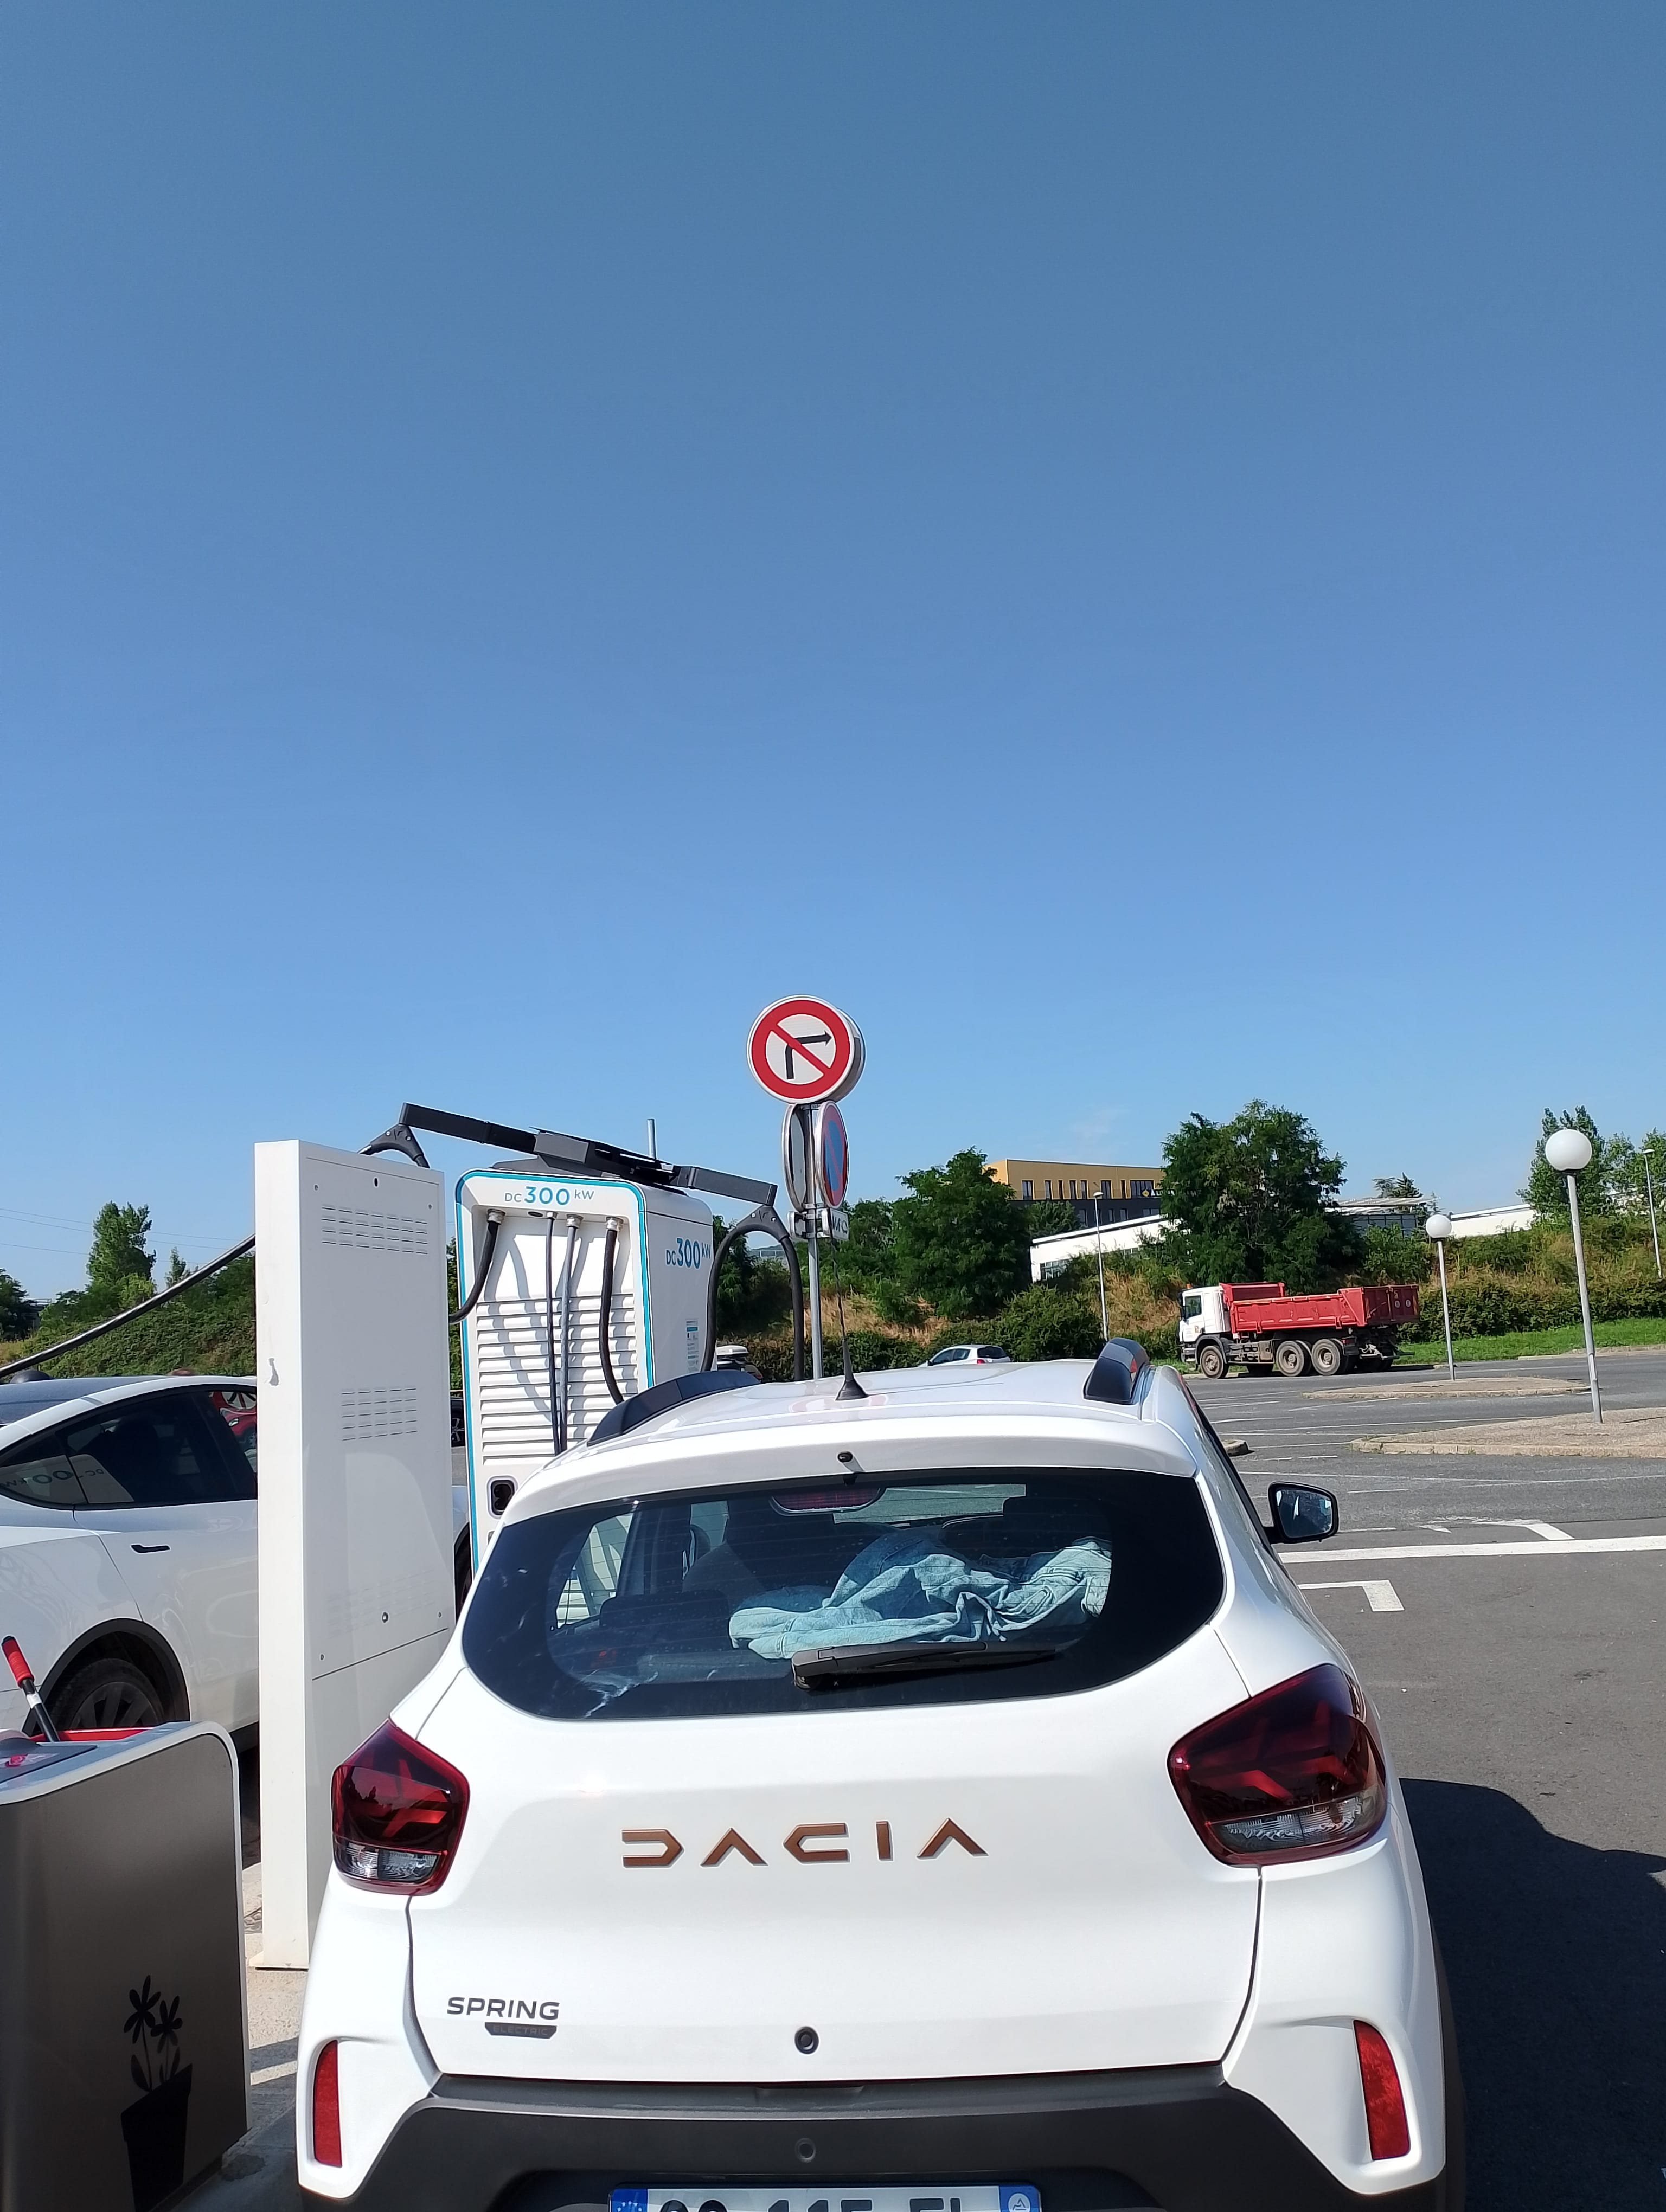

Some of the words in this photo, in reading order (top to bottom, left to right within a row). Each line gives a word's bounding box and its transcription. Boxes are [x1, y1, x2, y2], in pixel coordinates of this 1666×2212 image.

[505, 1192, 522, 1203] DC
[524, 1186, 571, 1206] 300
[574, 1189, 594, 1200] kW
[666, 1249, 676, 1266] DC
[676, 1237, 701, 1269] 300
[702, 1242, 711, 1259] kW
[621, 1817, 989, 1868] DACIA
[446, 1996, 560, 2021] SPRING
[492, 2024, 548, 2036] ELECTRIC
